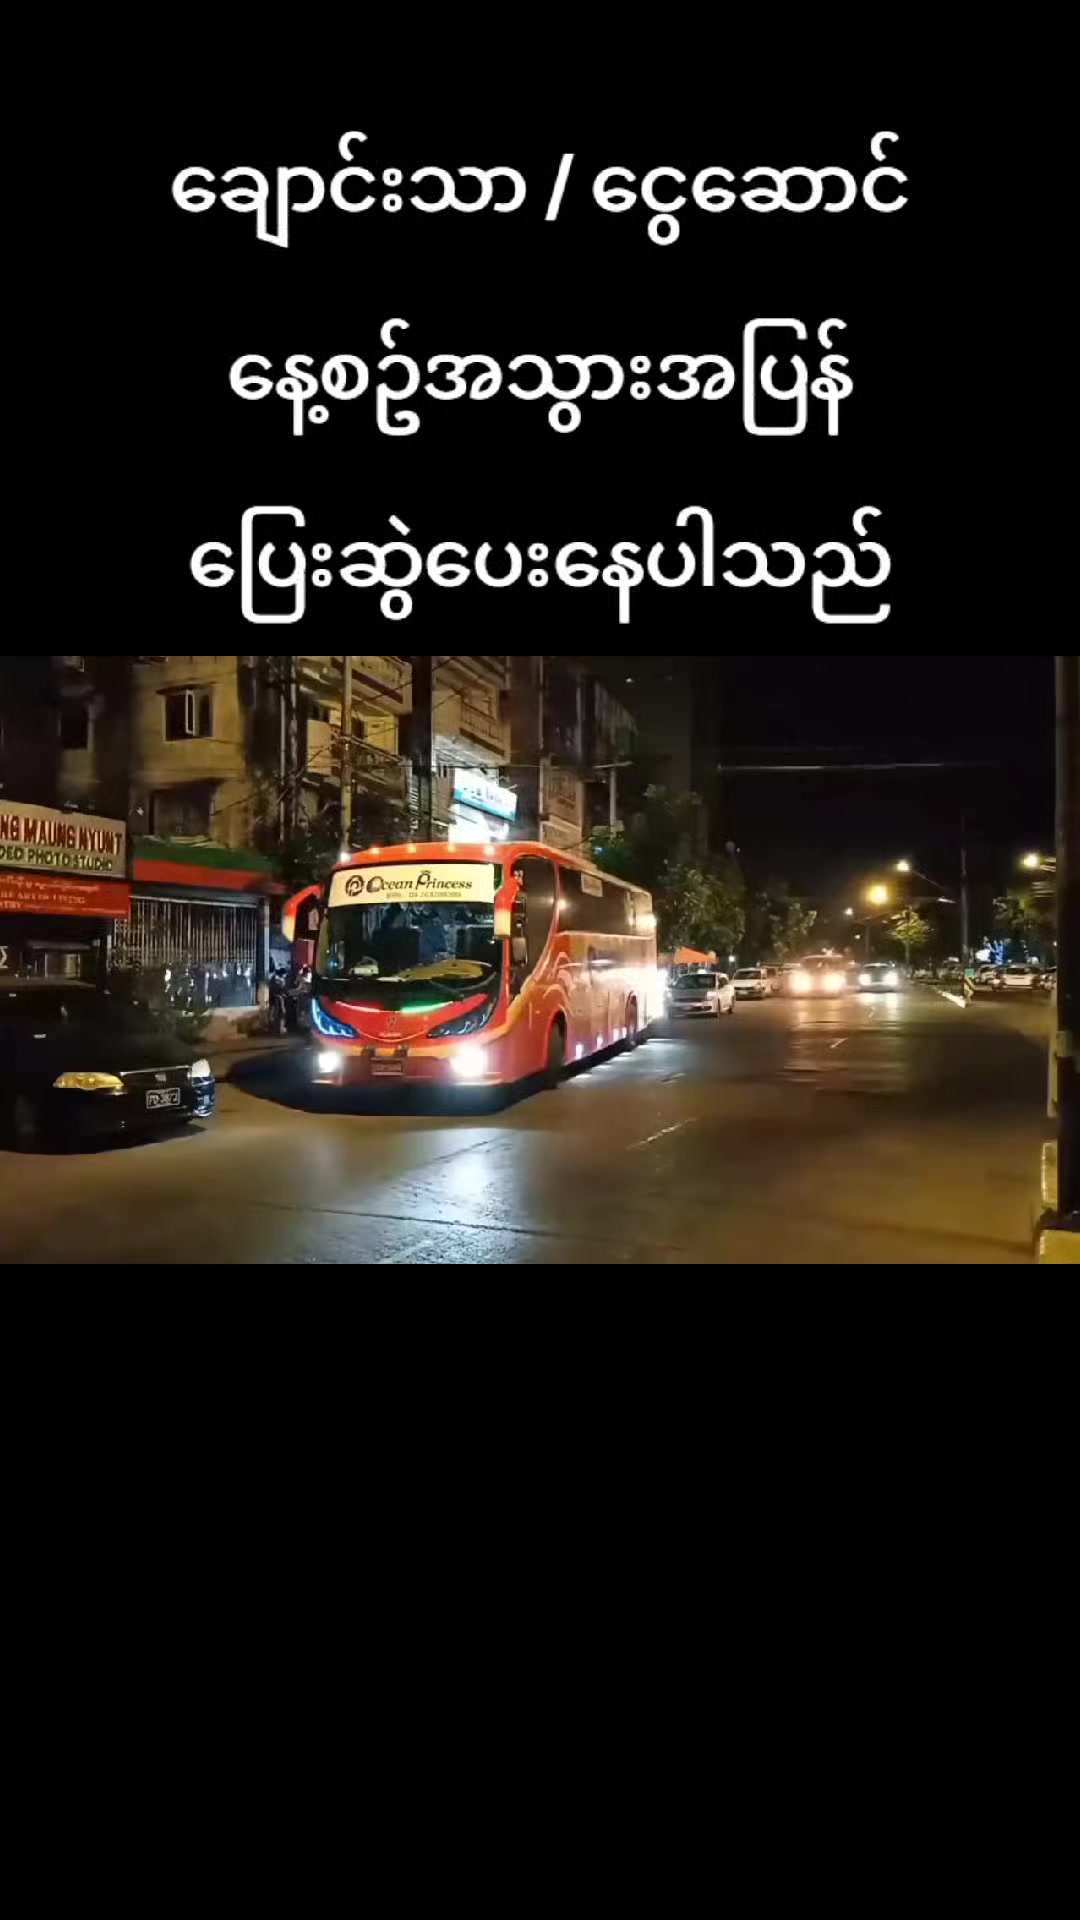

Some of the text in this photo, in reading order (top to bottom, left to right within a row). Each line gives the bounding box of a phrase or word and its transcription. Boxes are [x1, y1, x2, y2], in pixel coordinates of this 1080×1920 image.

[24, 818, 76, 849] MAUNG
[79, 826, 122, 854] NYUNT
[28, 848, 70, 866] PHOTO
[73, 855, 112, 872] STUDIO
[366, 870, 473, 893] Ocean Princess
